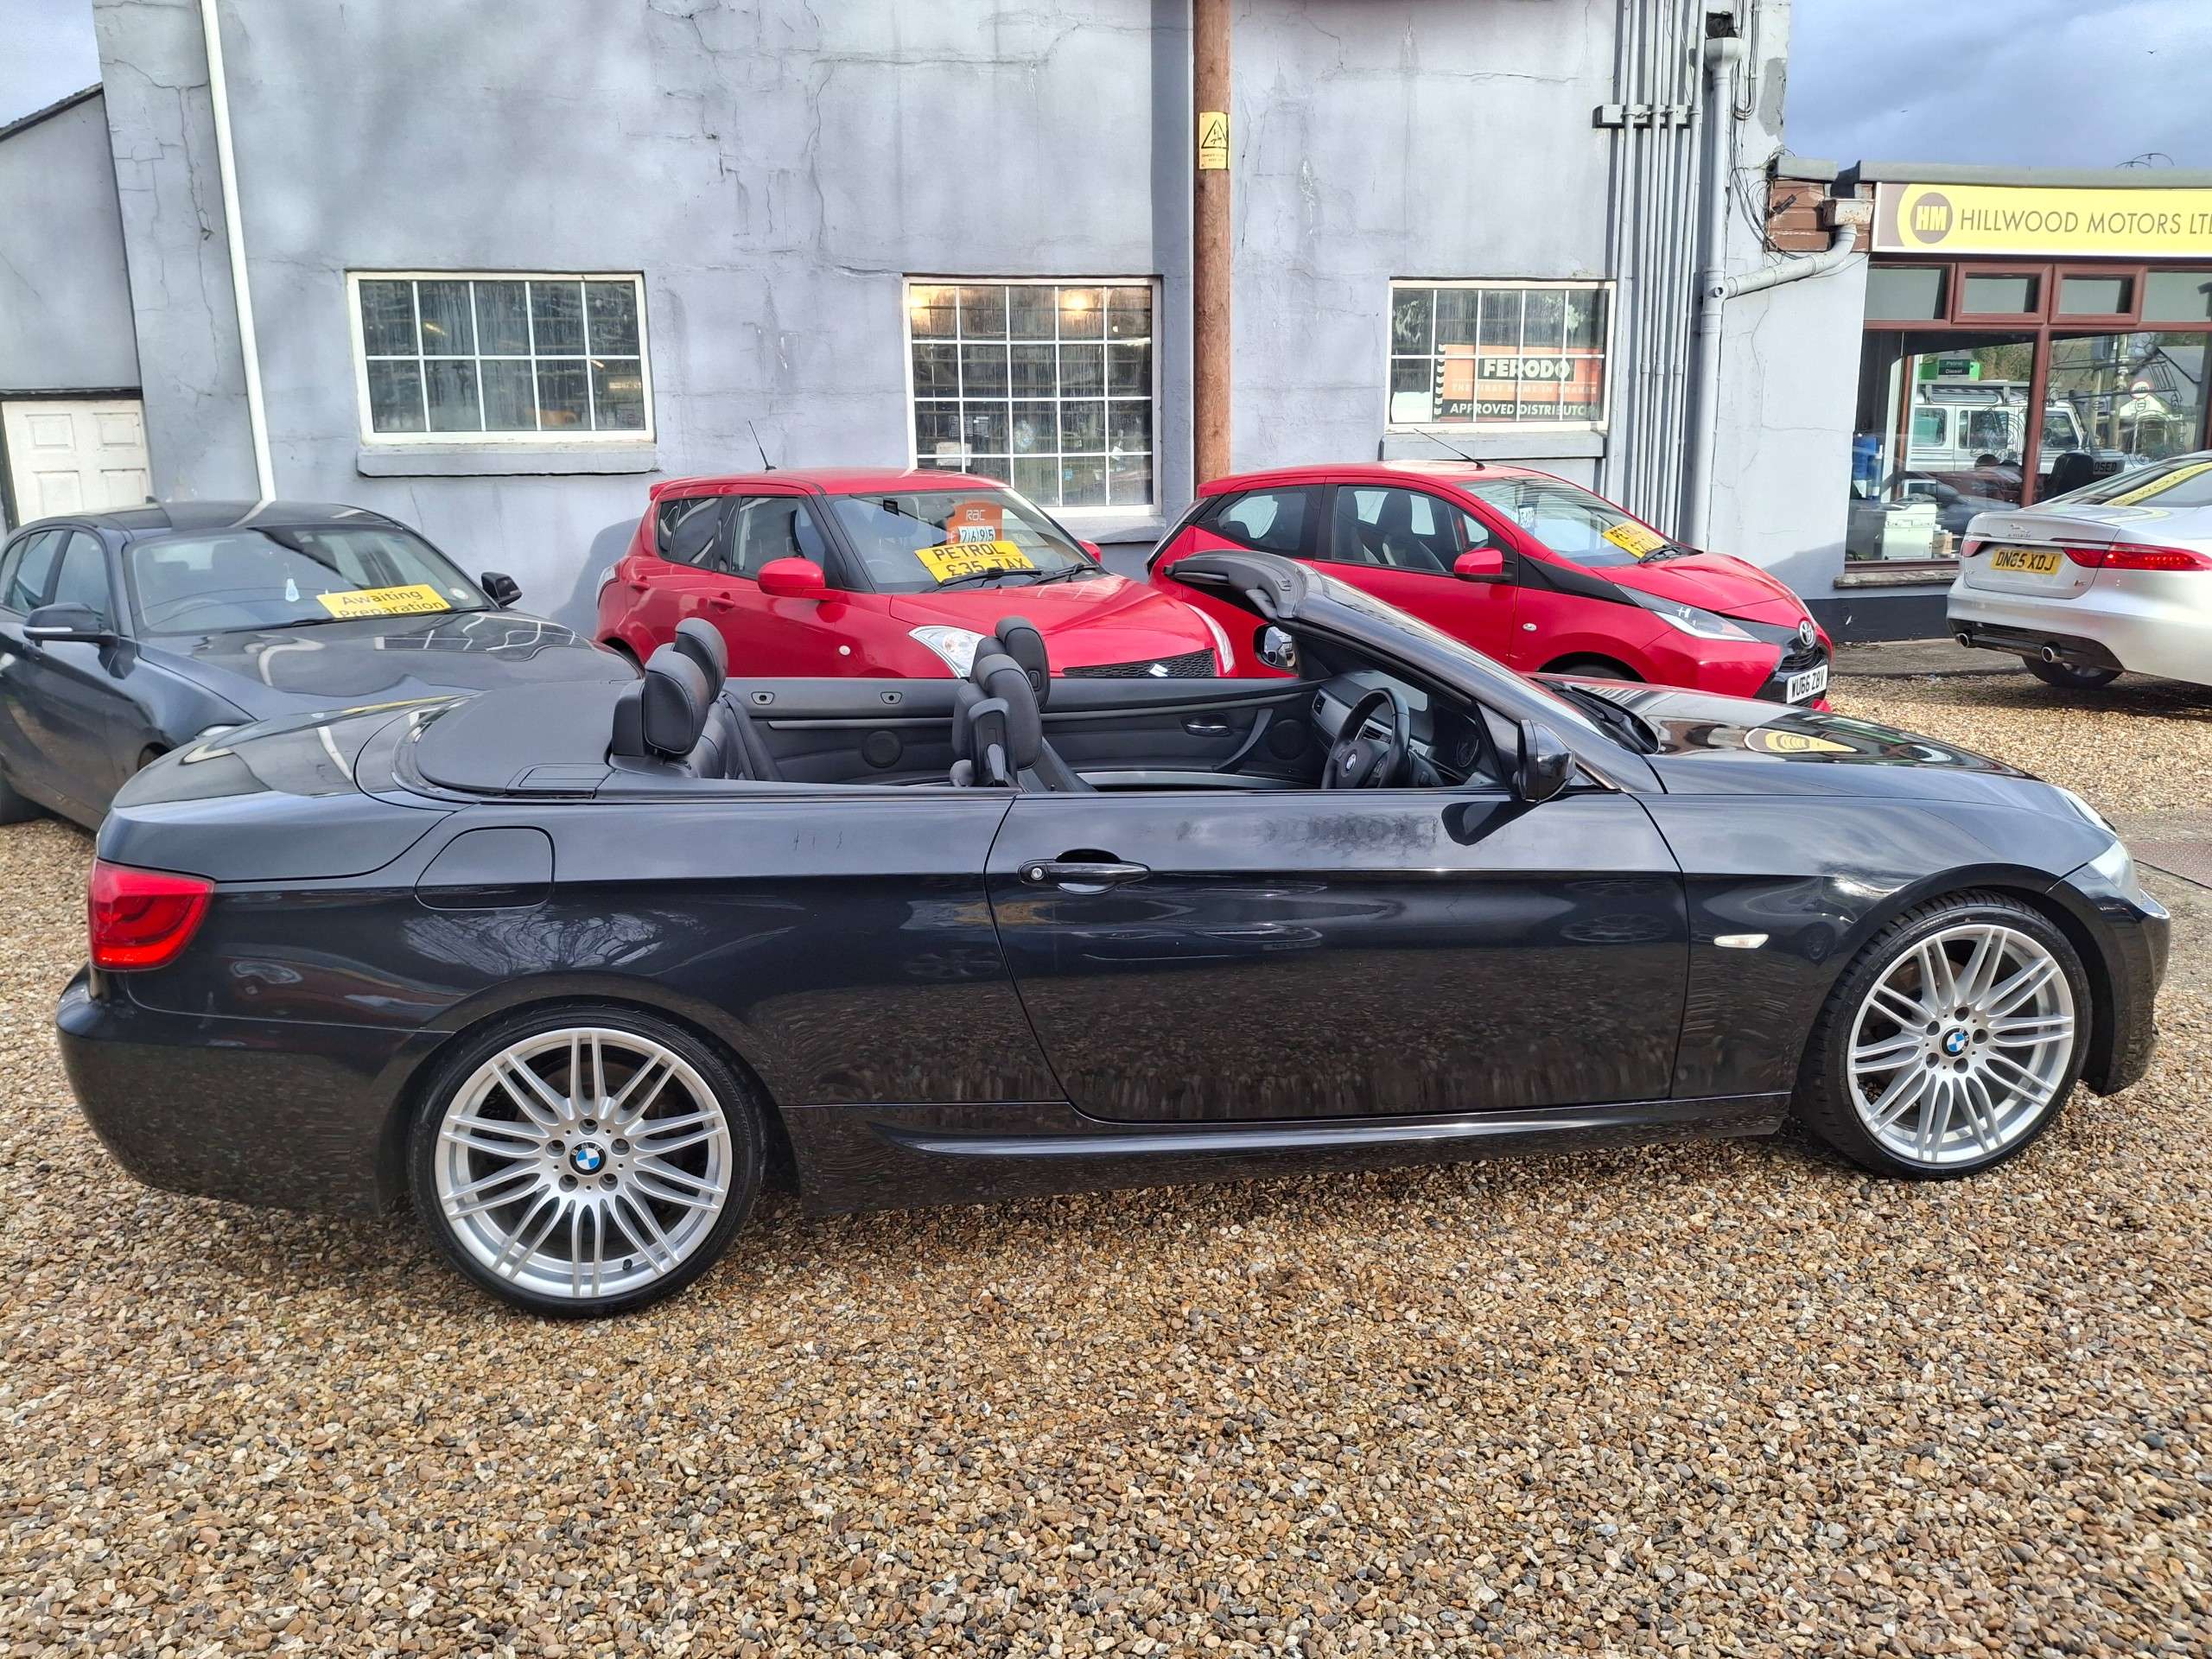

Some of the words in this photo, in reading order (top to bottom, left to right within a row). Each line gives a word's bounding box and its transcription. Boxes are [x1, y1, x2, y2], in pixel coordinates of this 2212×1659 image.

[1916, 206, 1948, 231] HM
[1960, 208, 2079, 233] HILLWOOD
[2086, 212, 2181, 235] MOTORS
[1483, 359, 1571, 378] FERODO
[932, 543, 1007, 562] PETROL
[945, 560, 985, 576] £35
[993, 557, 1029, 570] TAX
[2027, 554, 2056, 571] XDJ
[341, 590, 423, 606] Awaiting
